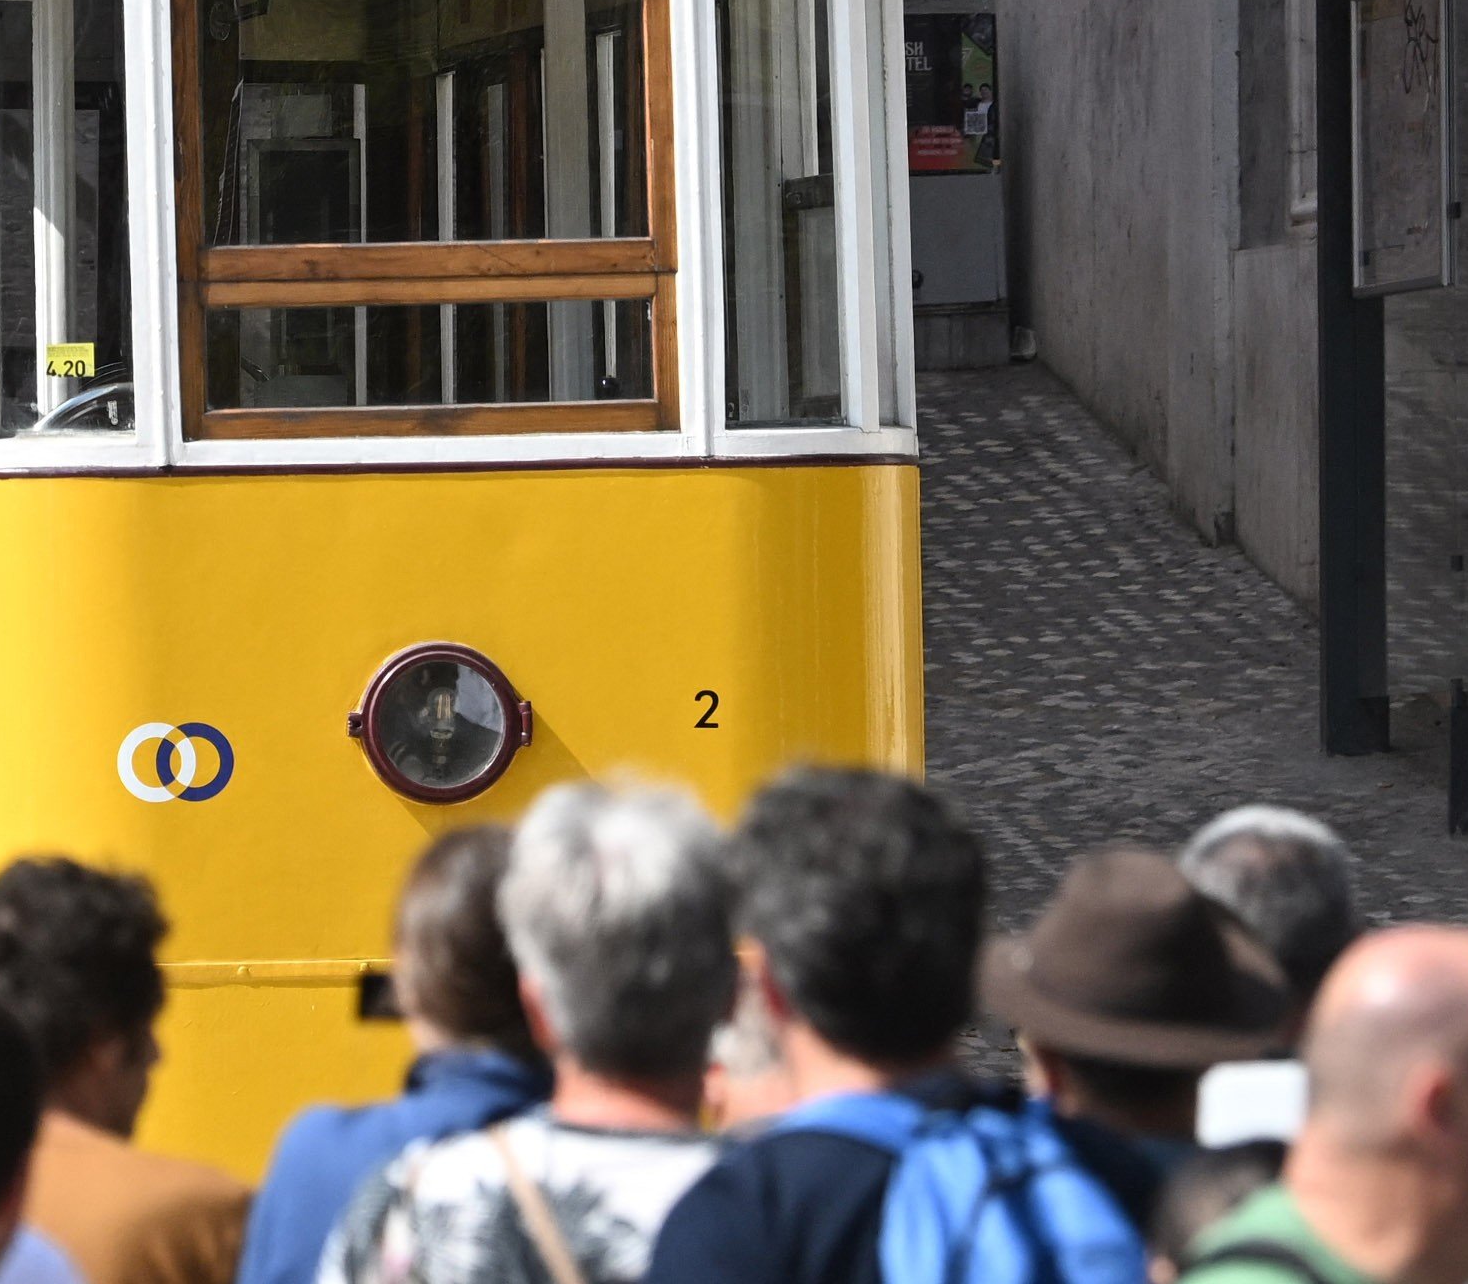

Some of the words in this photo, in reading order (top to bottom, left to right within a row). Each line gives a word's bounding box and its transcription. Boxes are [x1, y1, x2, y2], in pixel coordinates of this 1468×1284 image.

[905, 56, 933, 72] TEL
[46, 360, 86, 378] 4.20
[694, 690, 719, 729] 2
